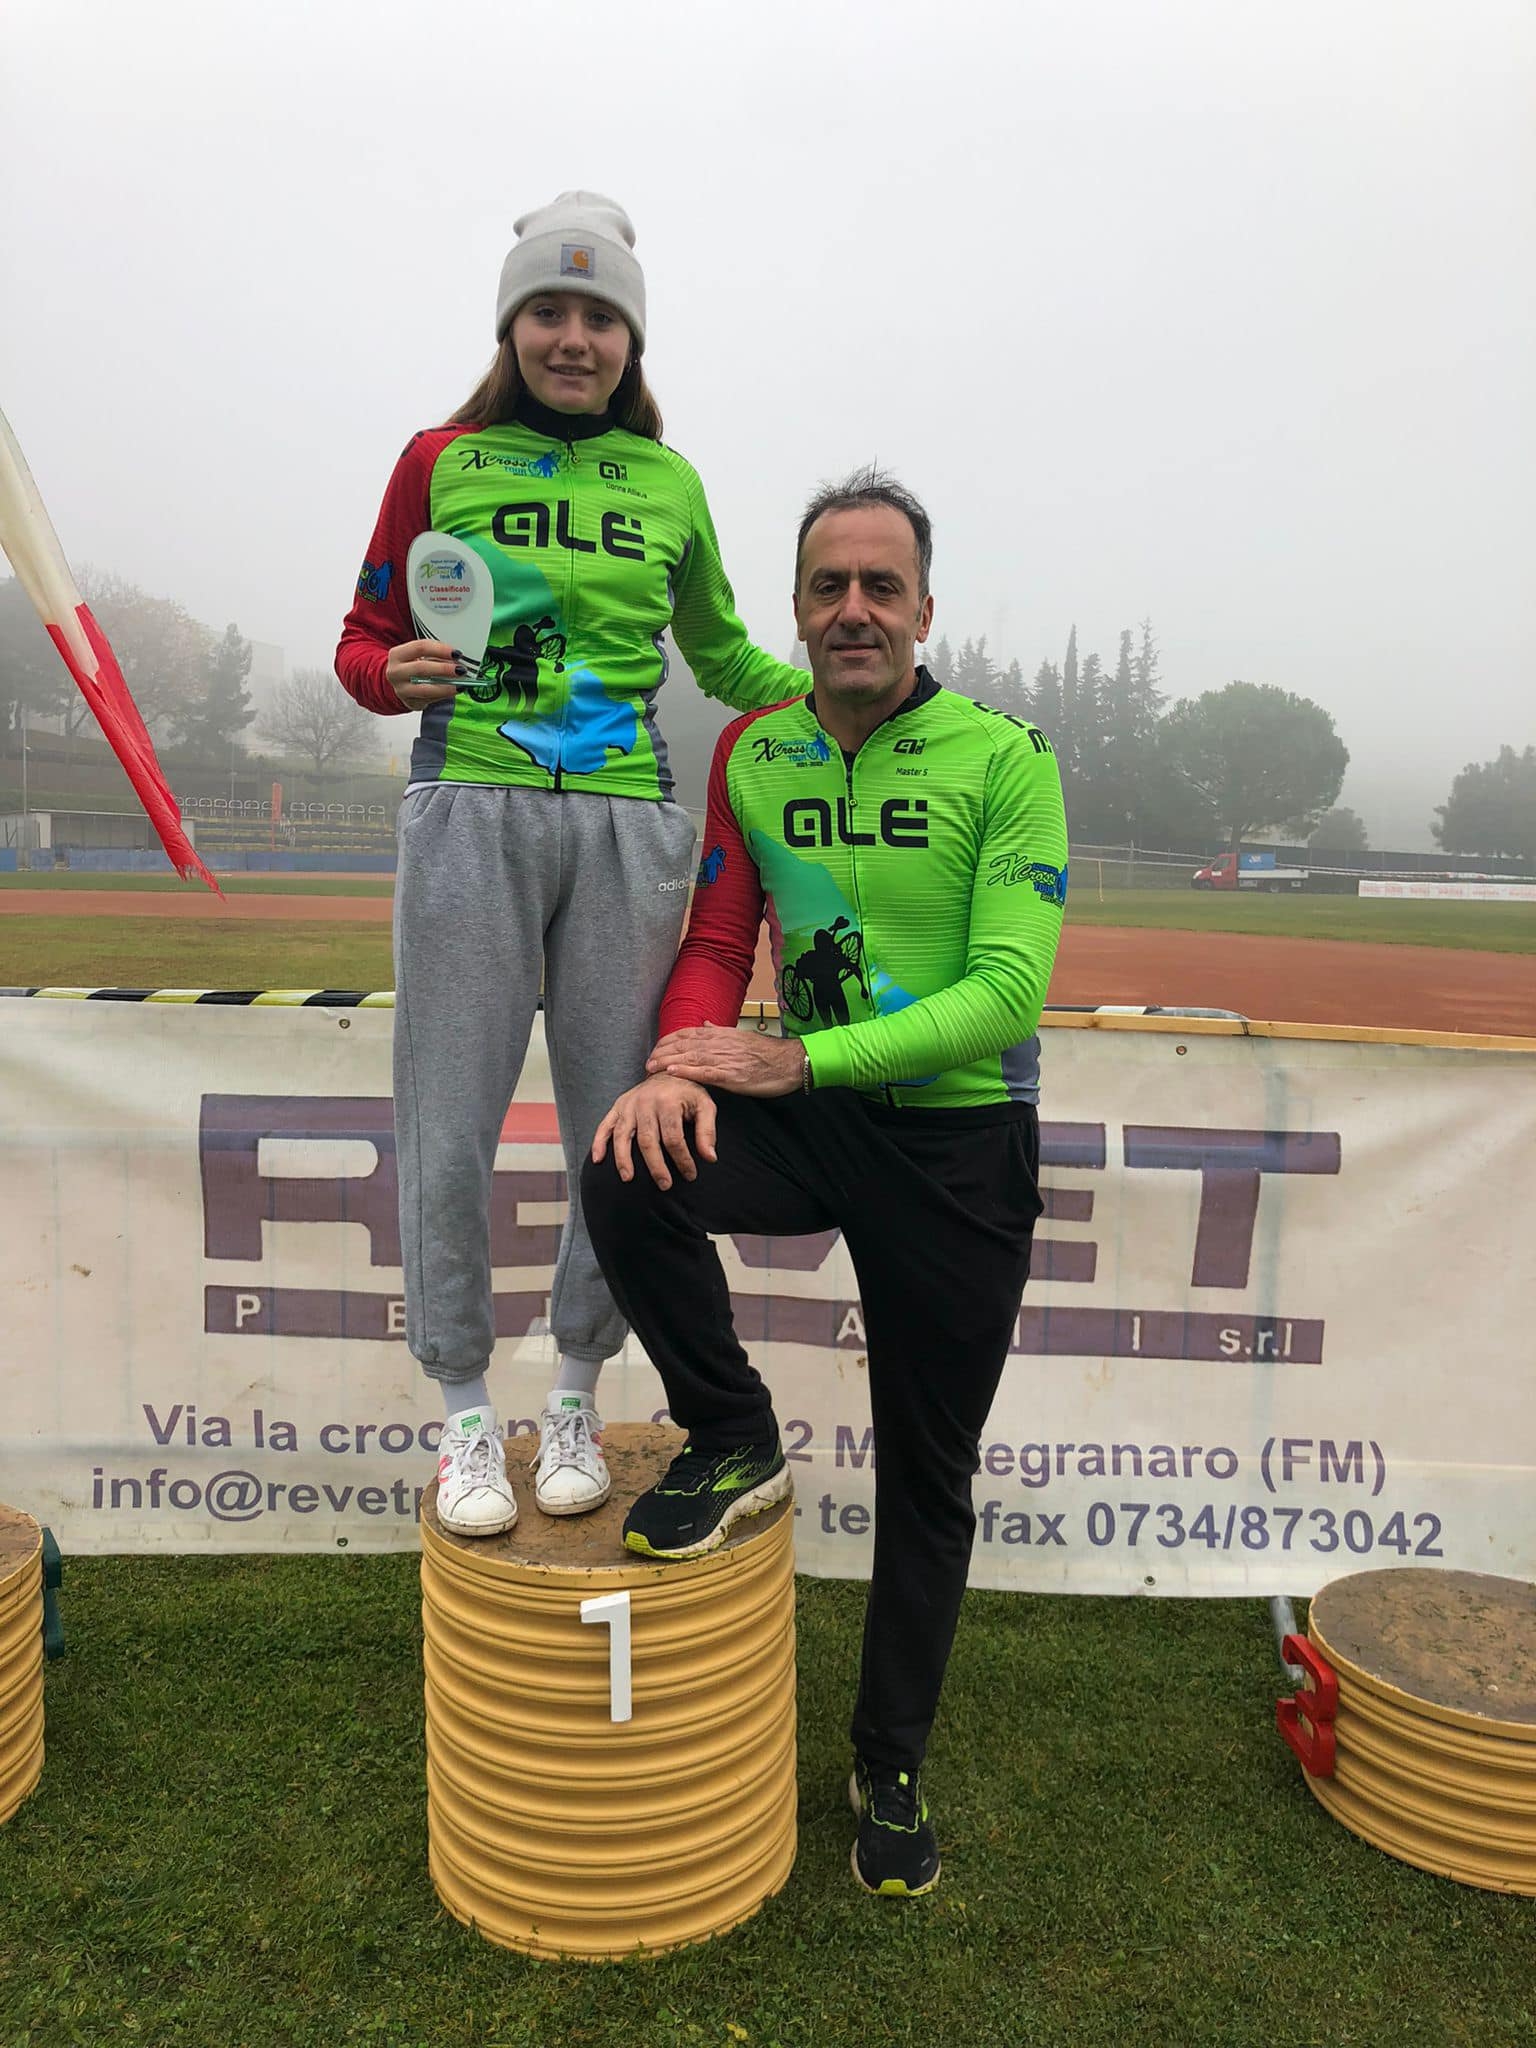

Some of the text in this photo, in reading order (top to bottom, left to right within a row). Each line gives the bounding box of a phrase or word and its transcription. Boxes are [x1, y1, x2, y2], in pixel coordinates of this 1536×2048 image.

[142, 1403, 233, 1448] Via
[253, 1409, 298, 1452] la
[1260, 1436, 1387, 1497] (FM)
[978, 1500, 1068, 1547] fax
[1086, 1502, 1444, 1558] 0734/873042
[580, 1590, 632, 1723] 1
